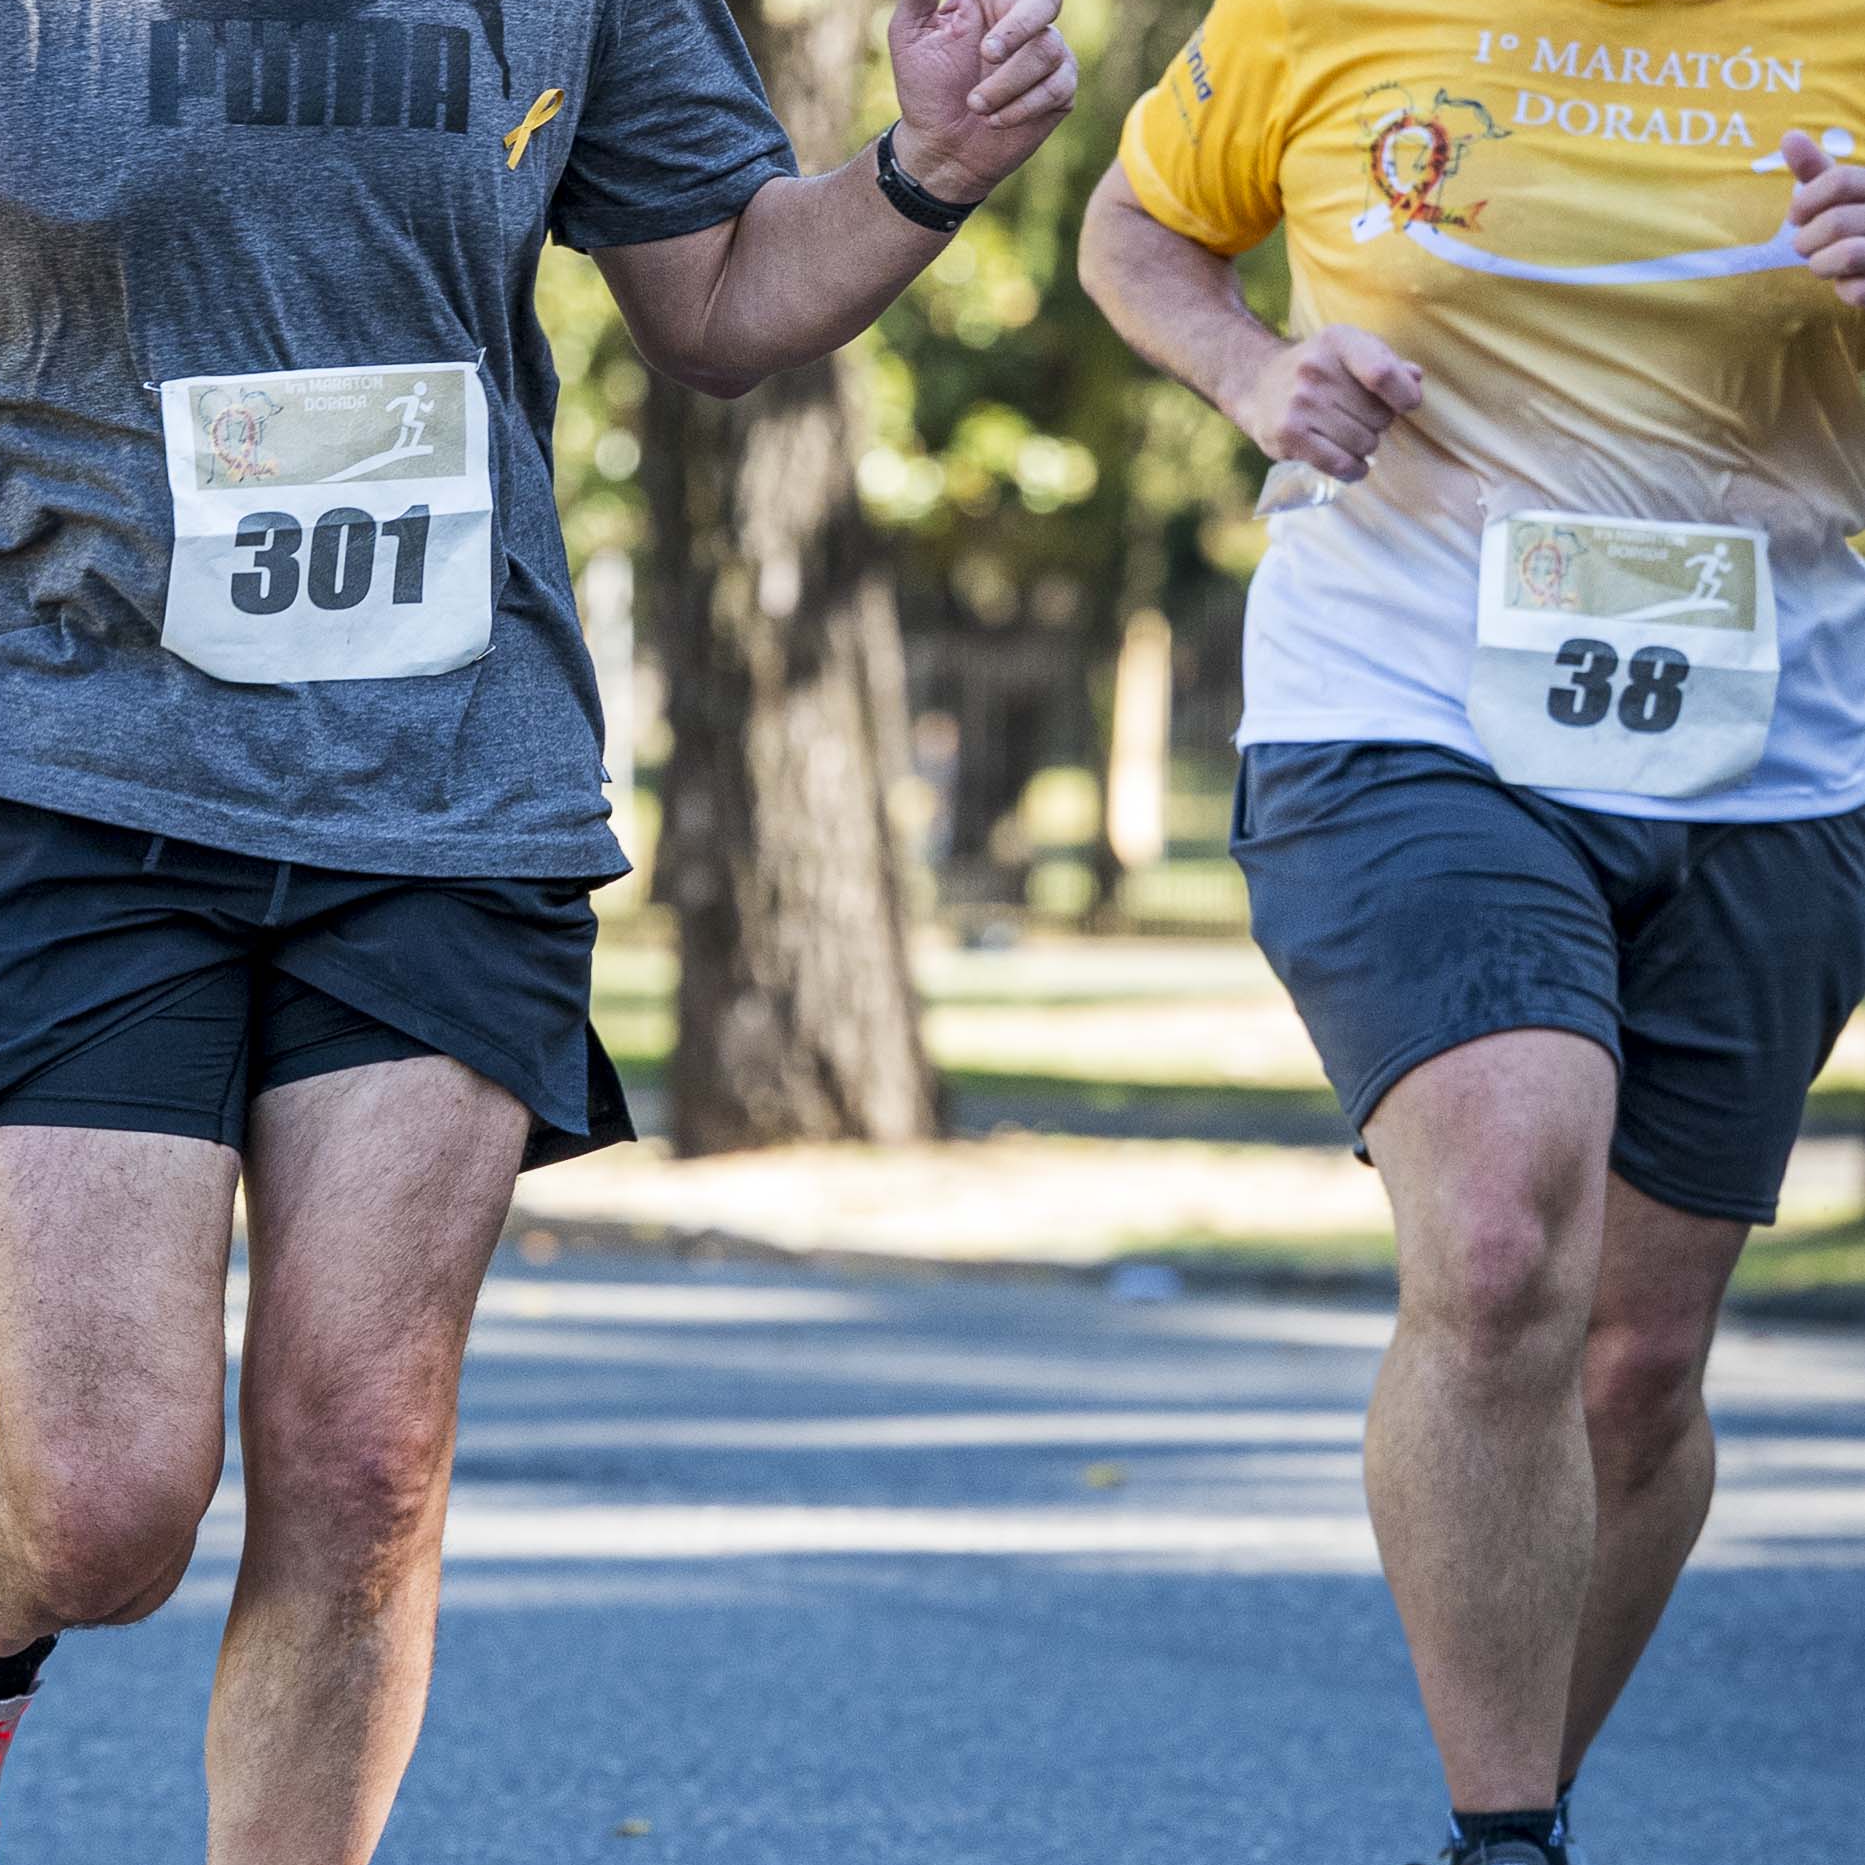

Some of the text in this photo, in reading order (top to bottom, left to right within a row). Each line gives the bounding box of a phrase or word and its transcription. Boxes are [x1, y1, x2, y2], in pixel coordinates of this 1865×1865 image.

[148, 19, 472, 135] PUMA
[1531, 36, 1804, 94] MARATÓN
[1512, 89, 1755, 148] DORADA
[231, 504, 430, 615] 301
[1547, 638, 1690, 734] 38
